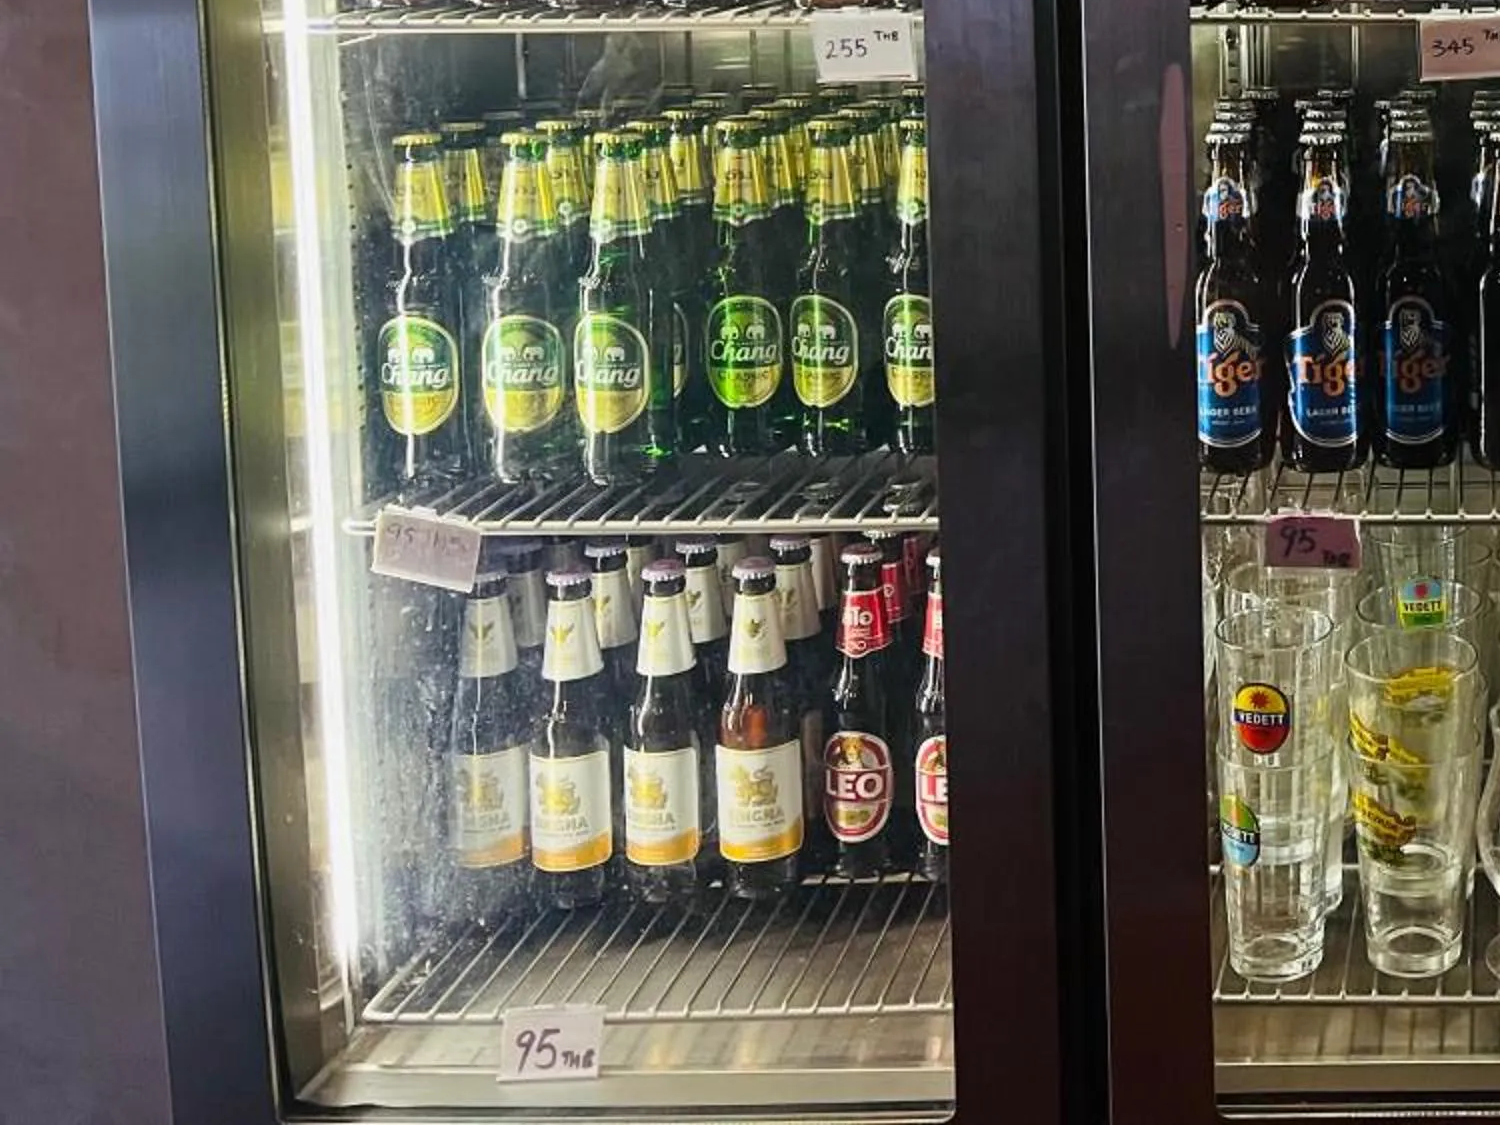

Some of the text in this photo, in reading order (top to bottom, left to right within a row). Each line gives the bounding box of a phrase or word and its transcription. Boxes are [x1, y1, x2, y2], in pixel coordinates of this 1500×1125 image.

[825, 38, 869, 60] 255
[1431, 40, 1476, 59] 345
[711, 340, 777, 363] Chang
[791, 337, 850, 365] Chang
[885, 336, 933, 361] Chan
[381, 362, 450, 387] Chang
[576, 361, 641, 388] Cang
[1279, 526, 1317, 558] 95
[826, 770, 885, 799] LEO
[921, 772, 948, 802] LE
[515, 1028, 561, 1074] 95
